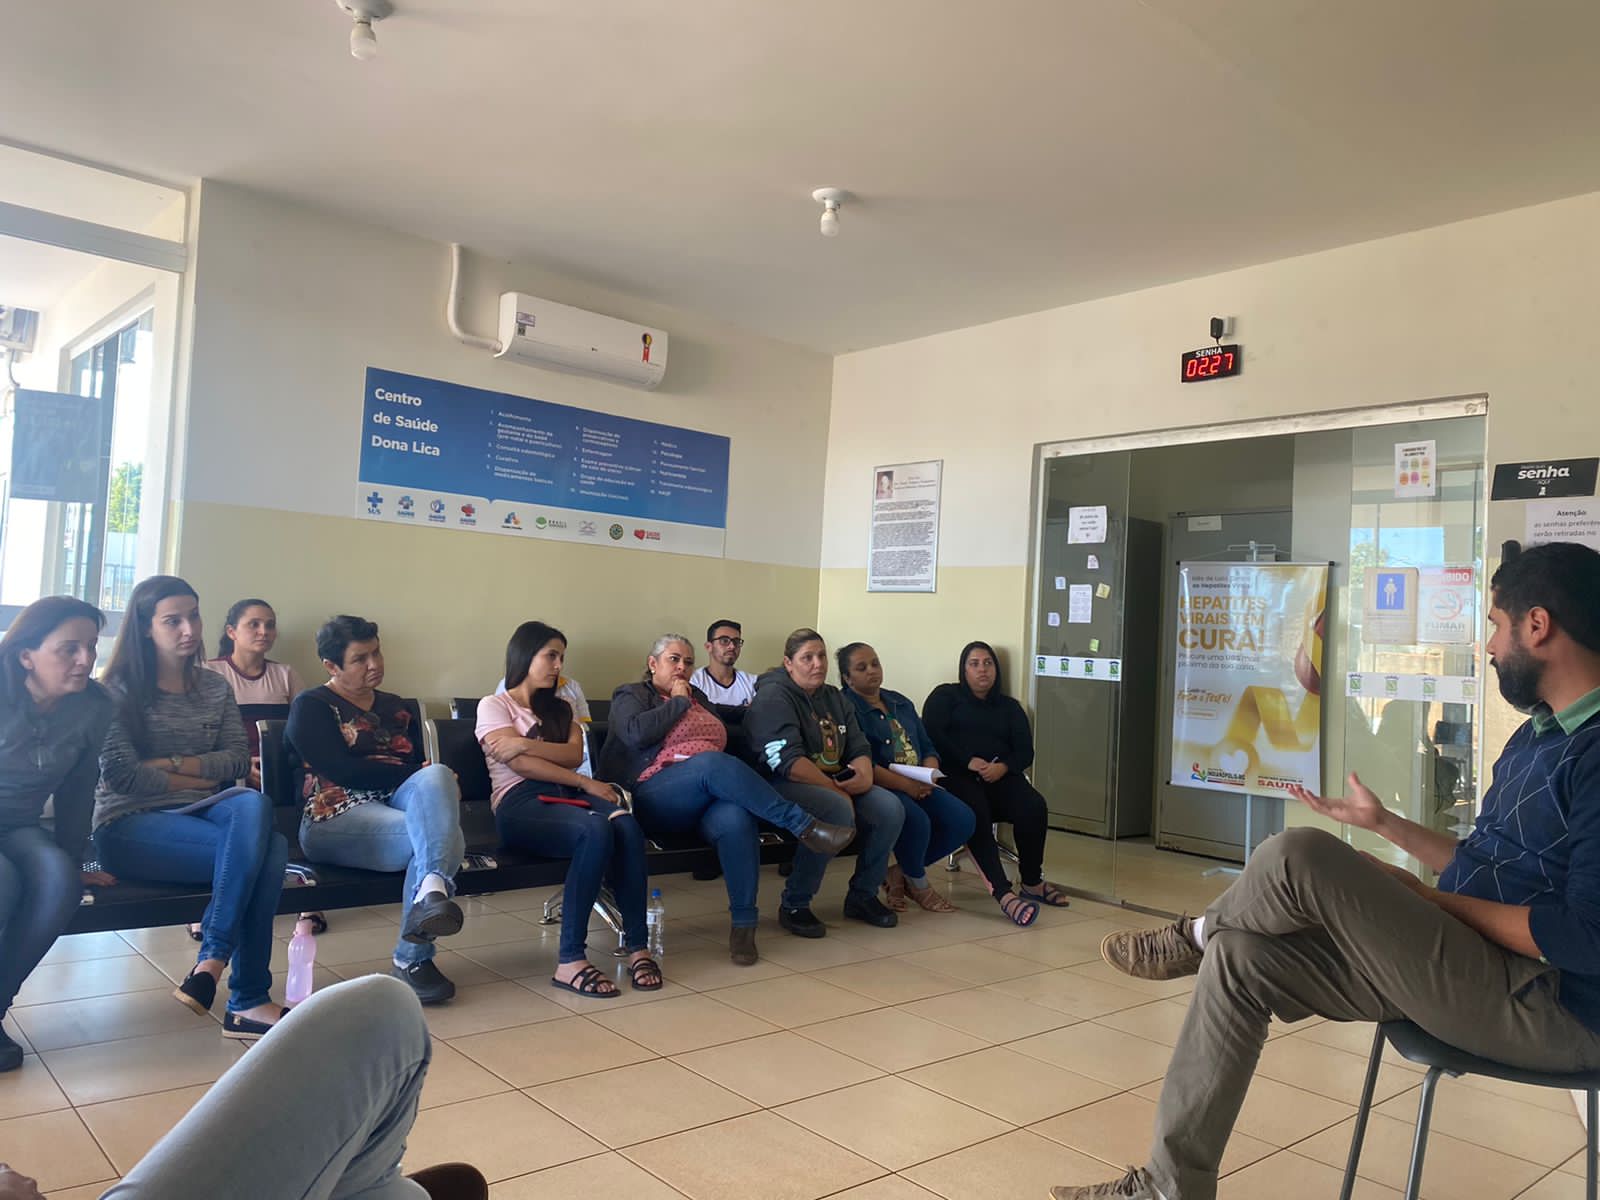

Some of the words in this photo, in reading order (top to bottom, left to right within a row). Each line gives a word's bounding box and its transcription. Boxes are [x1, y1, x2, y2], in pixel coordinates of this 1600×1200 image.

[1195, 347, 1223, 358] SENHA
[1186, 353, 1234, 377] 0227
[375, 388, 422, 406] Centro
[373, 412, 391, 424] de
[395, 415, 439, 432] Saúde
[371, 435, 408, 451] Dona
[412, 441, 440, 456] Lica
[1517, 465, 1570, 480] senha
[1180, 596, 1265, 609] HEPATITES
[1180, 612, 1229, 625] VIRAIS
[1179, 629, 1264, 653] CURA!
